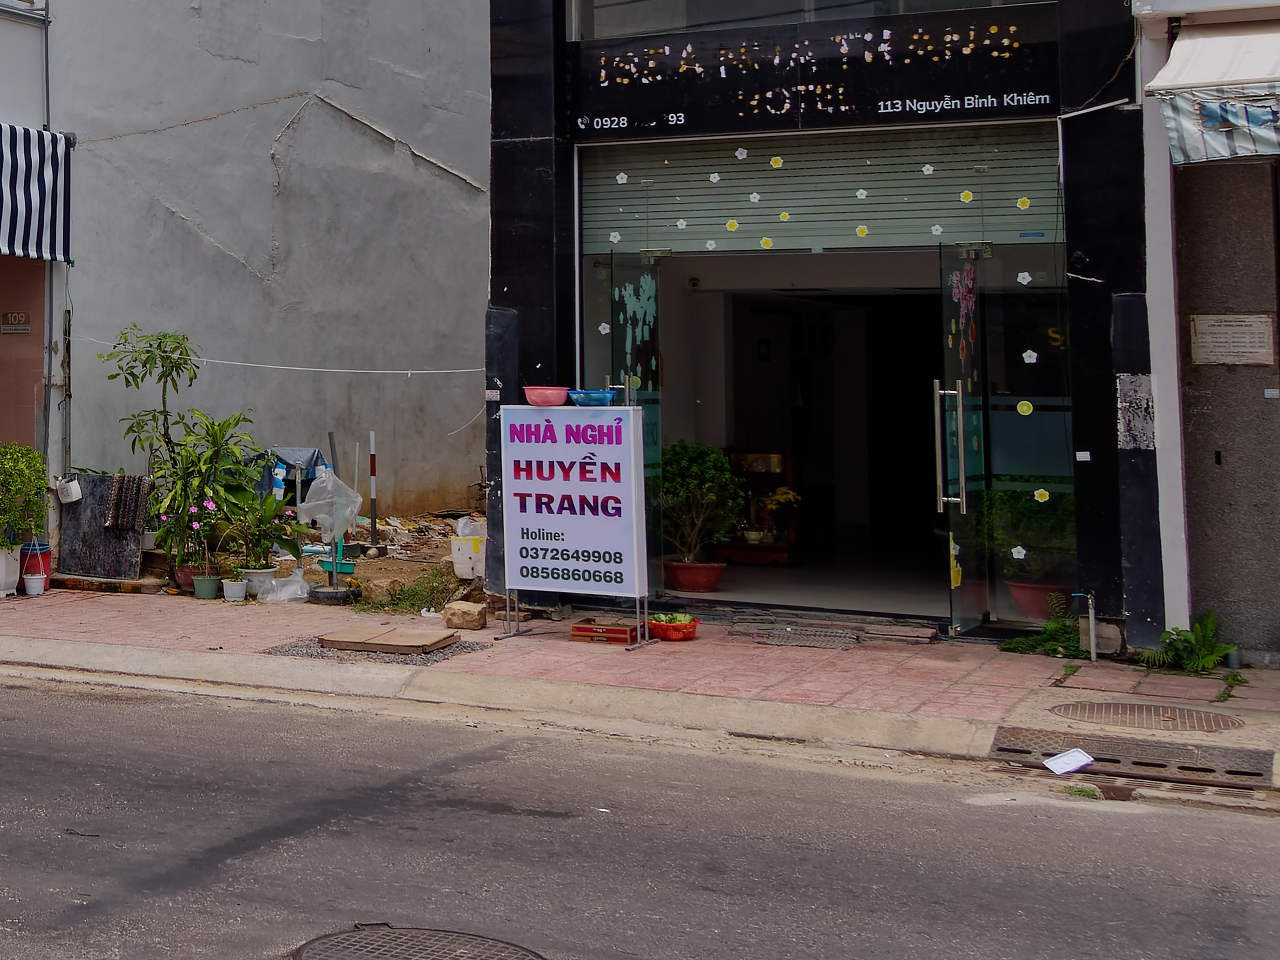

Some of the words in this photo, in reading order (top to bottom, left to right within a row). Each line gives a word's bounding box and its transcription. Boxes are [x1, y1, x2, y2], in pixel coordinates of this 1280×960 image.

[877, 101, 902, 113] 113
[906, 95, 961, 113] Nguyễn
[1003, 92, 1050, 107] Khiêm
[593, 116, 628, 128] 0928
[8, 313, 25, 324] 109
[509, 418, 558, 444] NHÀ
[565, 417, 623, 445] NGHỈ
[513, 452, 623, 483] HUYỀN
[512, 493, 622, 517] TRANG
[521, 528, 565, 542] Holine:
[519, 546, 623, 564] 0372649908
[519, 566, 624, 584] 0856860668
